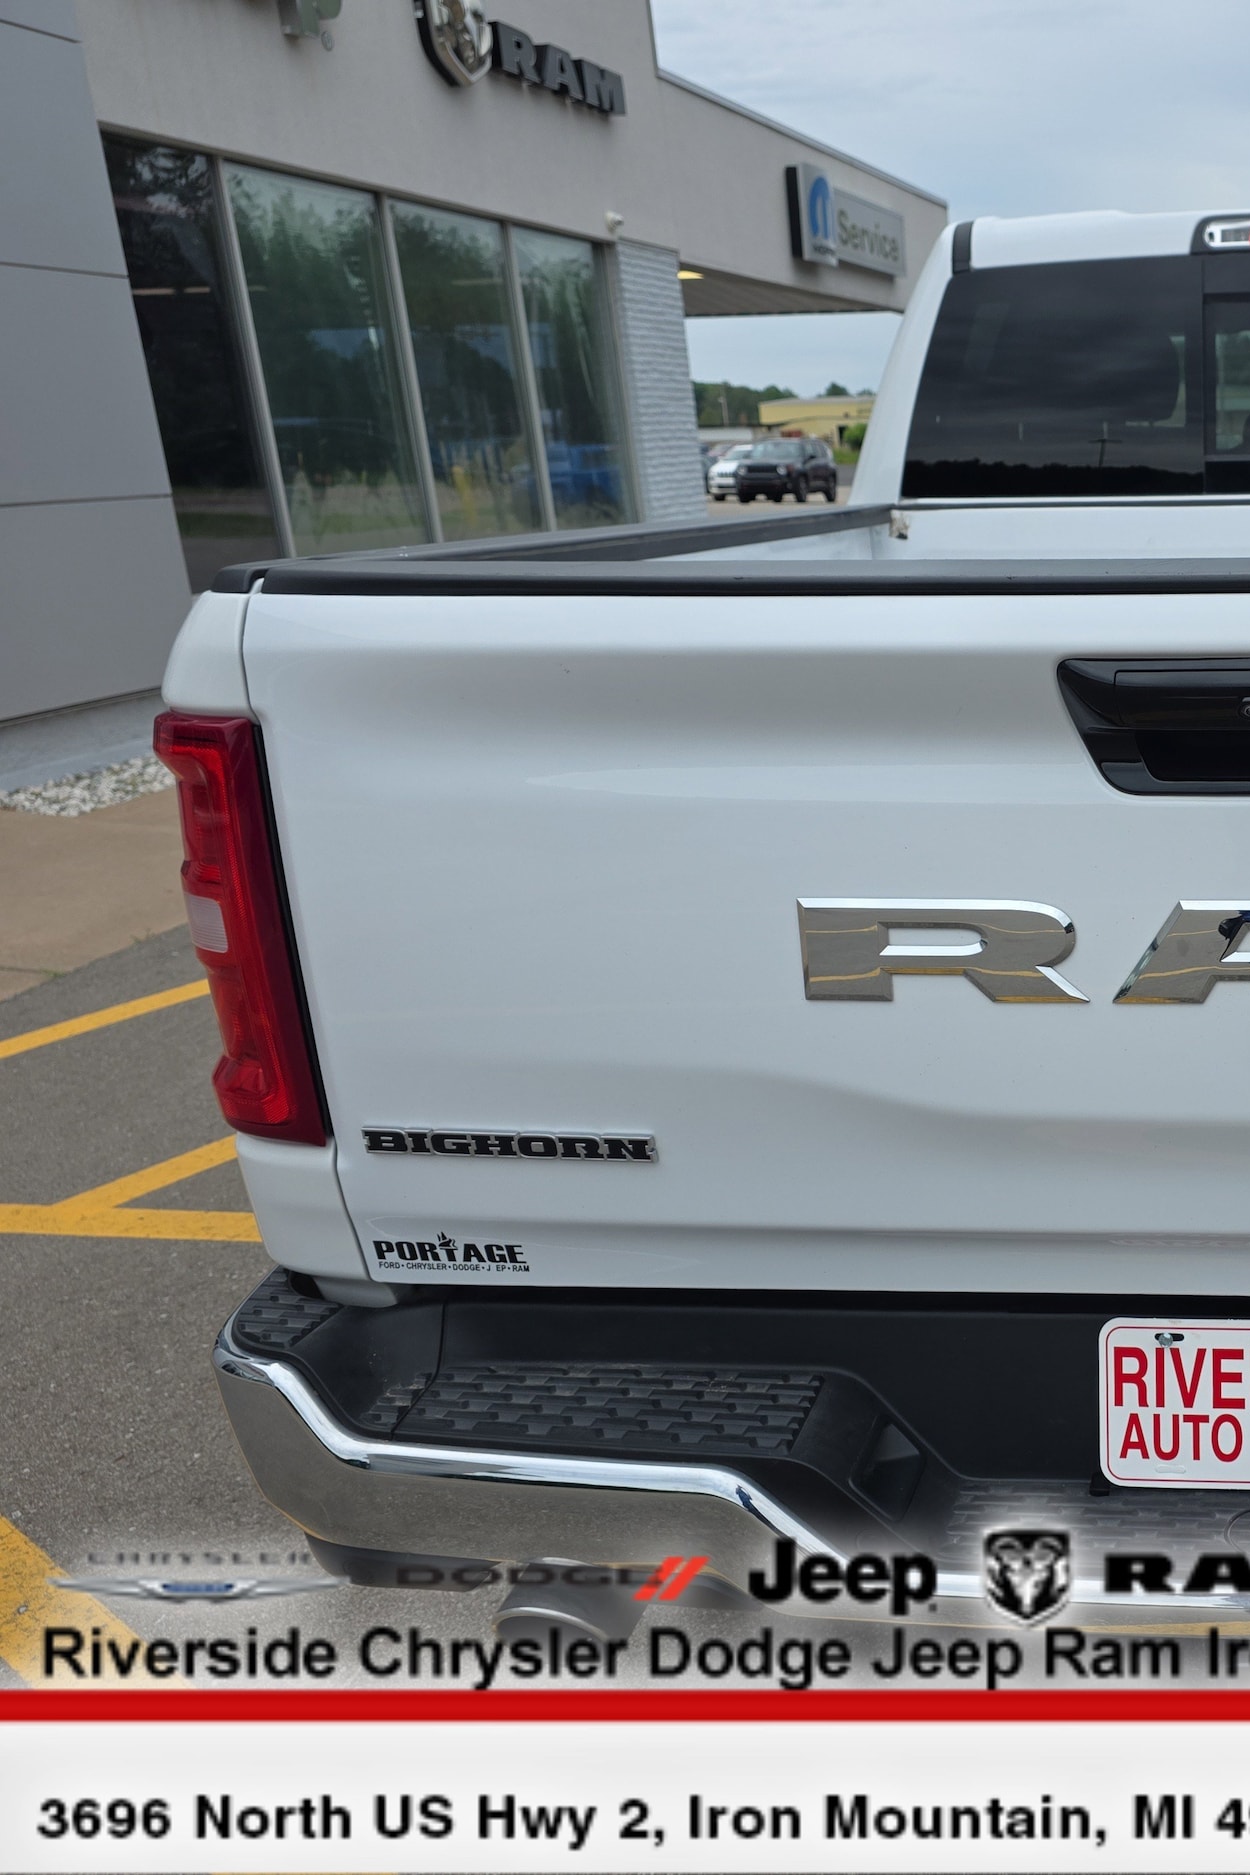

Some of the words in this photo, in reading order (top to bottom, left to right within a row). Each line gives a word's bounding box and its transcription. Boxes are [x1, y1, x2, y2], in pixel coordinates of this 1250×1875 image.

[489, 20, 626, 116] RAM
[838, 207, 899, 262] Service
[362, 1126, 657, 1163] BIGHORN
[373, 1239, 527, 1264] PORTAGE
[378, 1261, 400, 1269] FORD
[406, 1262, 447, 1271] CHRYSLER
[452, 1264, 481, 1272] DODGE
[512, 1265, 530, 1273] RAM
[1120, 1413, 1243, 1462] AUTO
